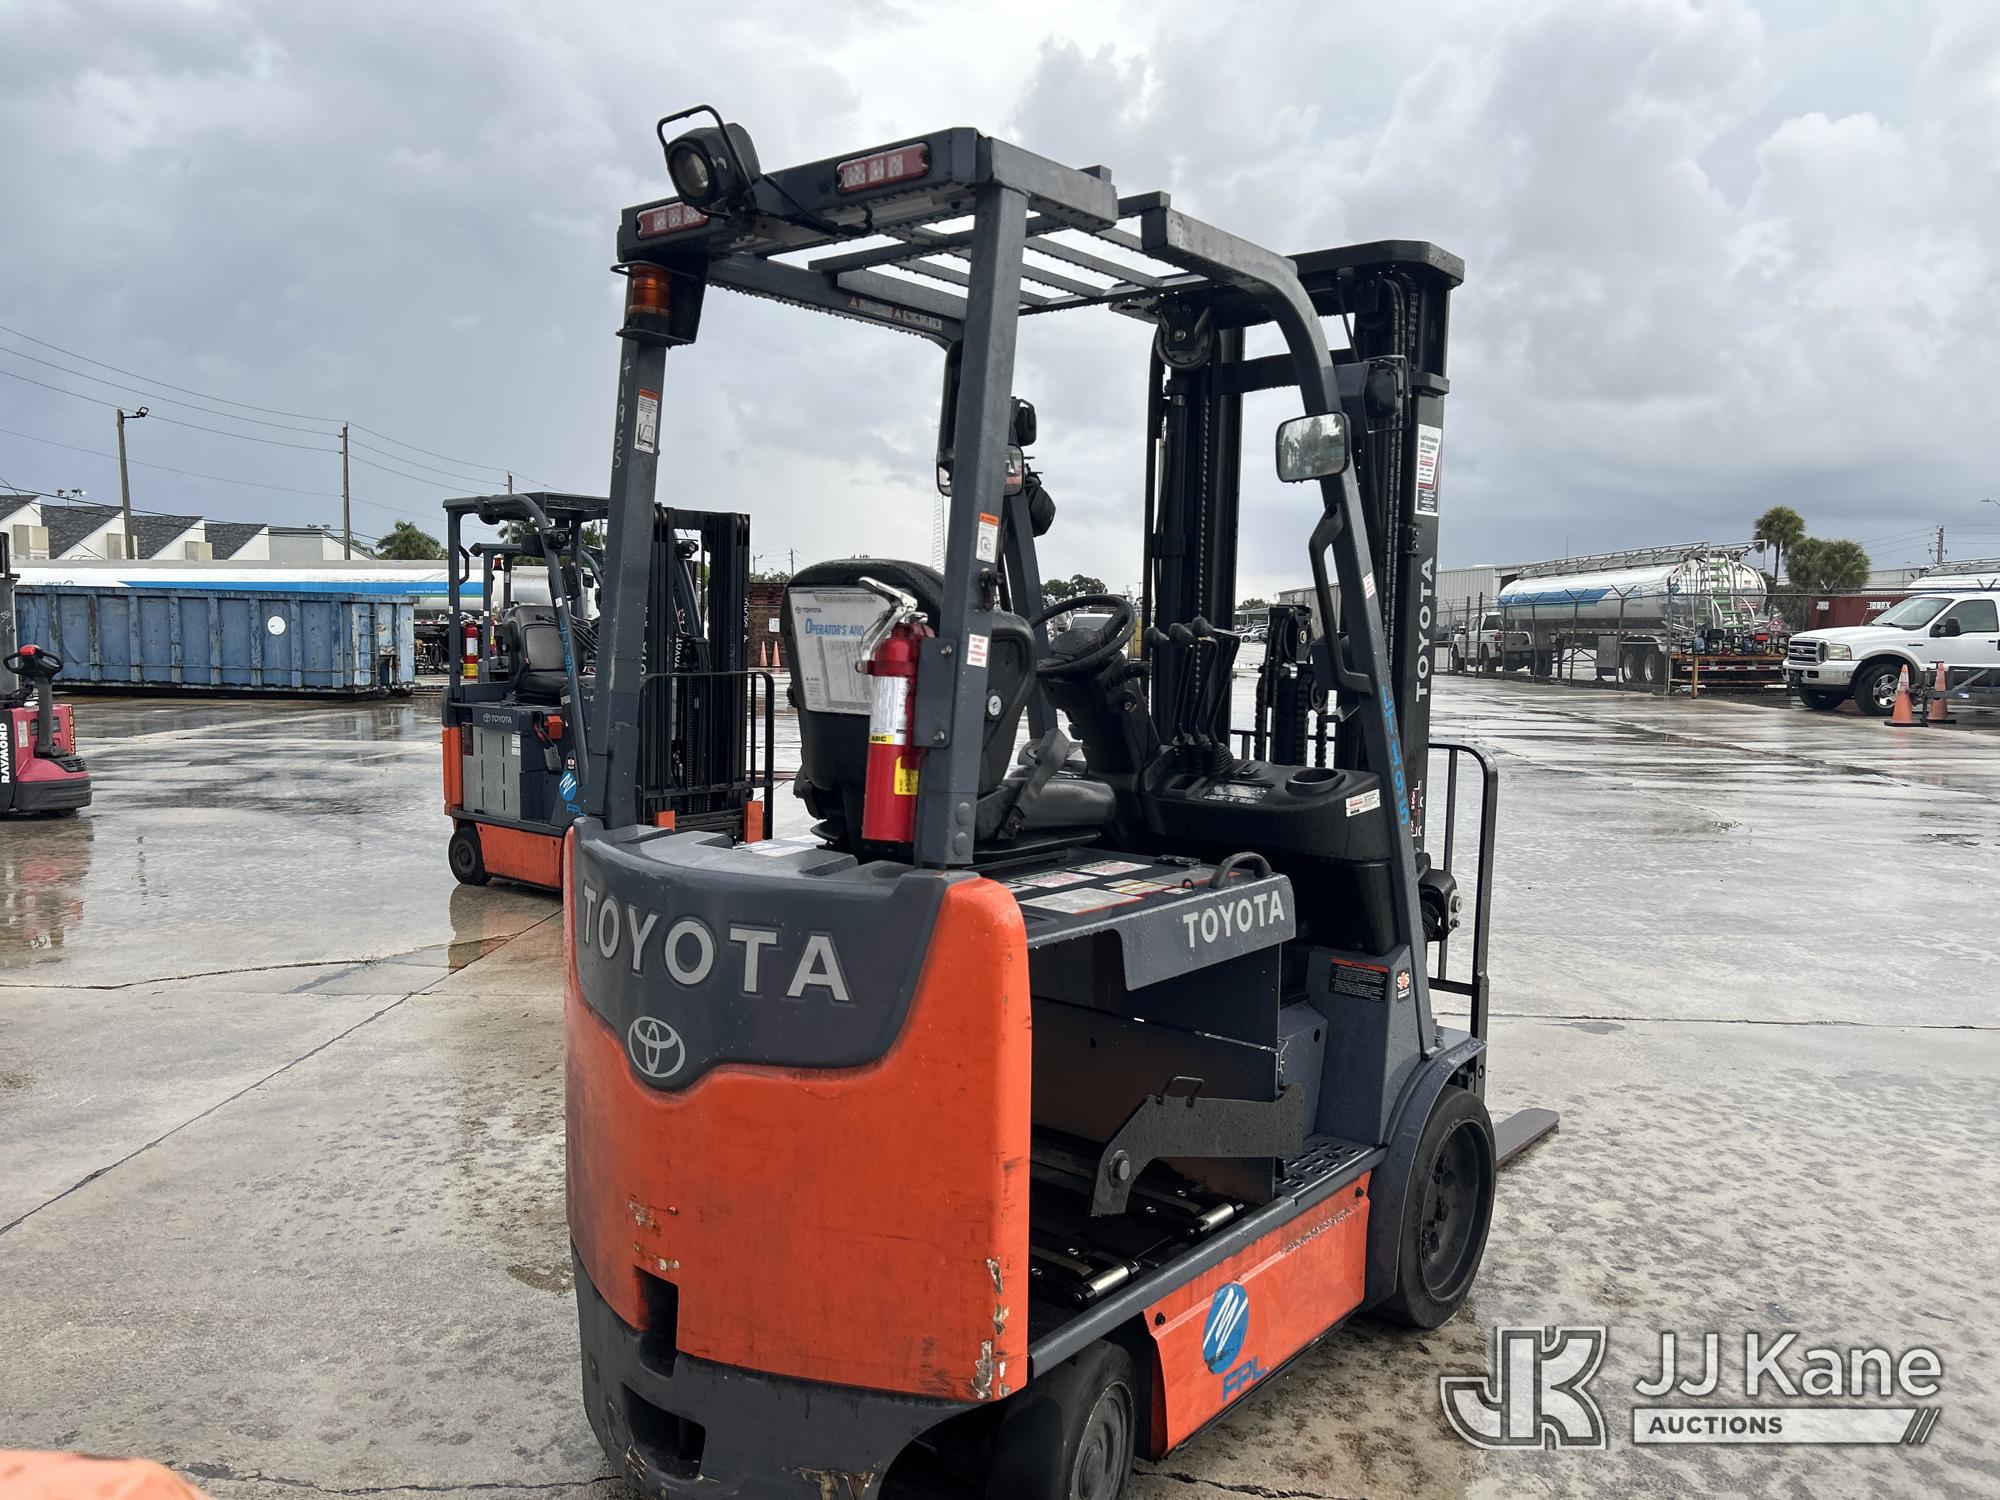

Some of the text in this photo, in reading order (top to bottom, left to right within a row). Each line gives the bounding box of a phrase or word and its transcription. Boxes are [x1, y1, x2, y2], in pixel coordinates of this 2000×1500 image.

[1415, 556, 1434, 703] TOYOTA
[491, 714, 513, 724] TOYOTA
[0, 722, 10, 784] RAYMOND
[566, 803, 585, 816] FPL
[583, 882, 850, 1002] TOYOTA
[1183, 889, 1286, 949] TOYOTA
[1222, 1355, 1266, 1403] FPL
